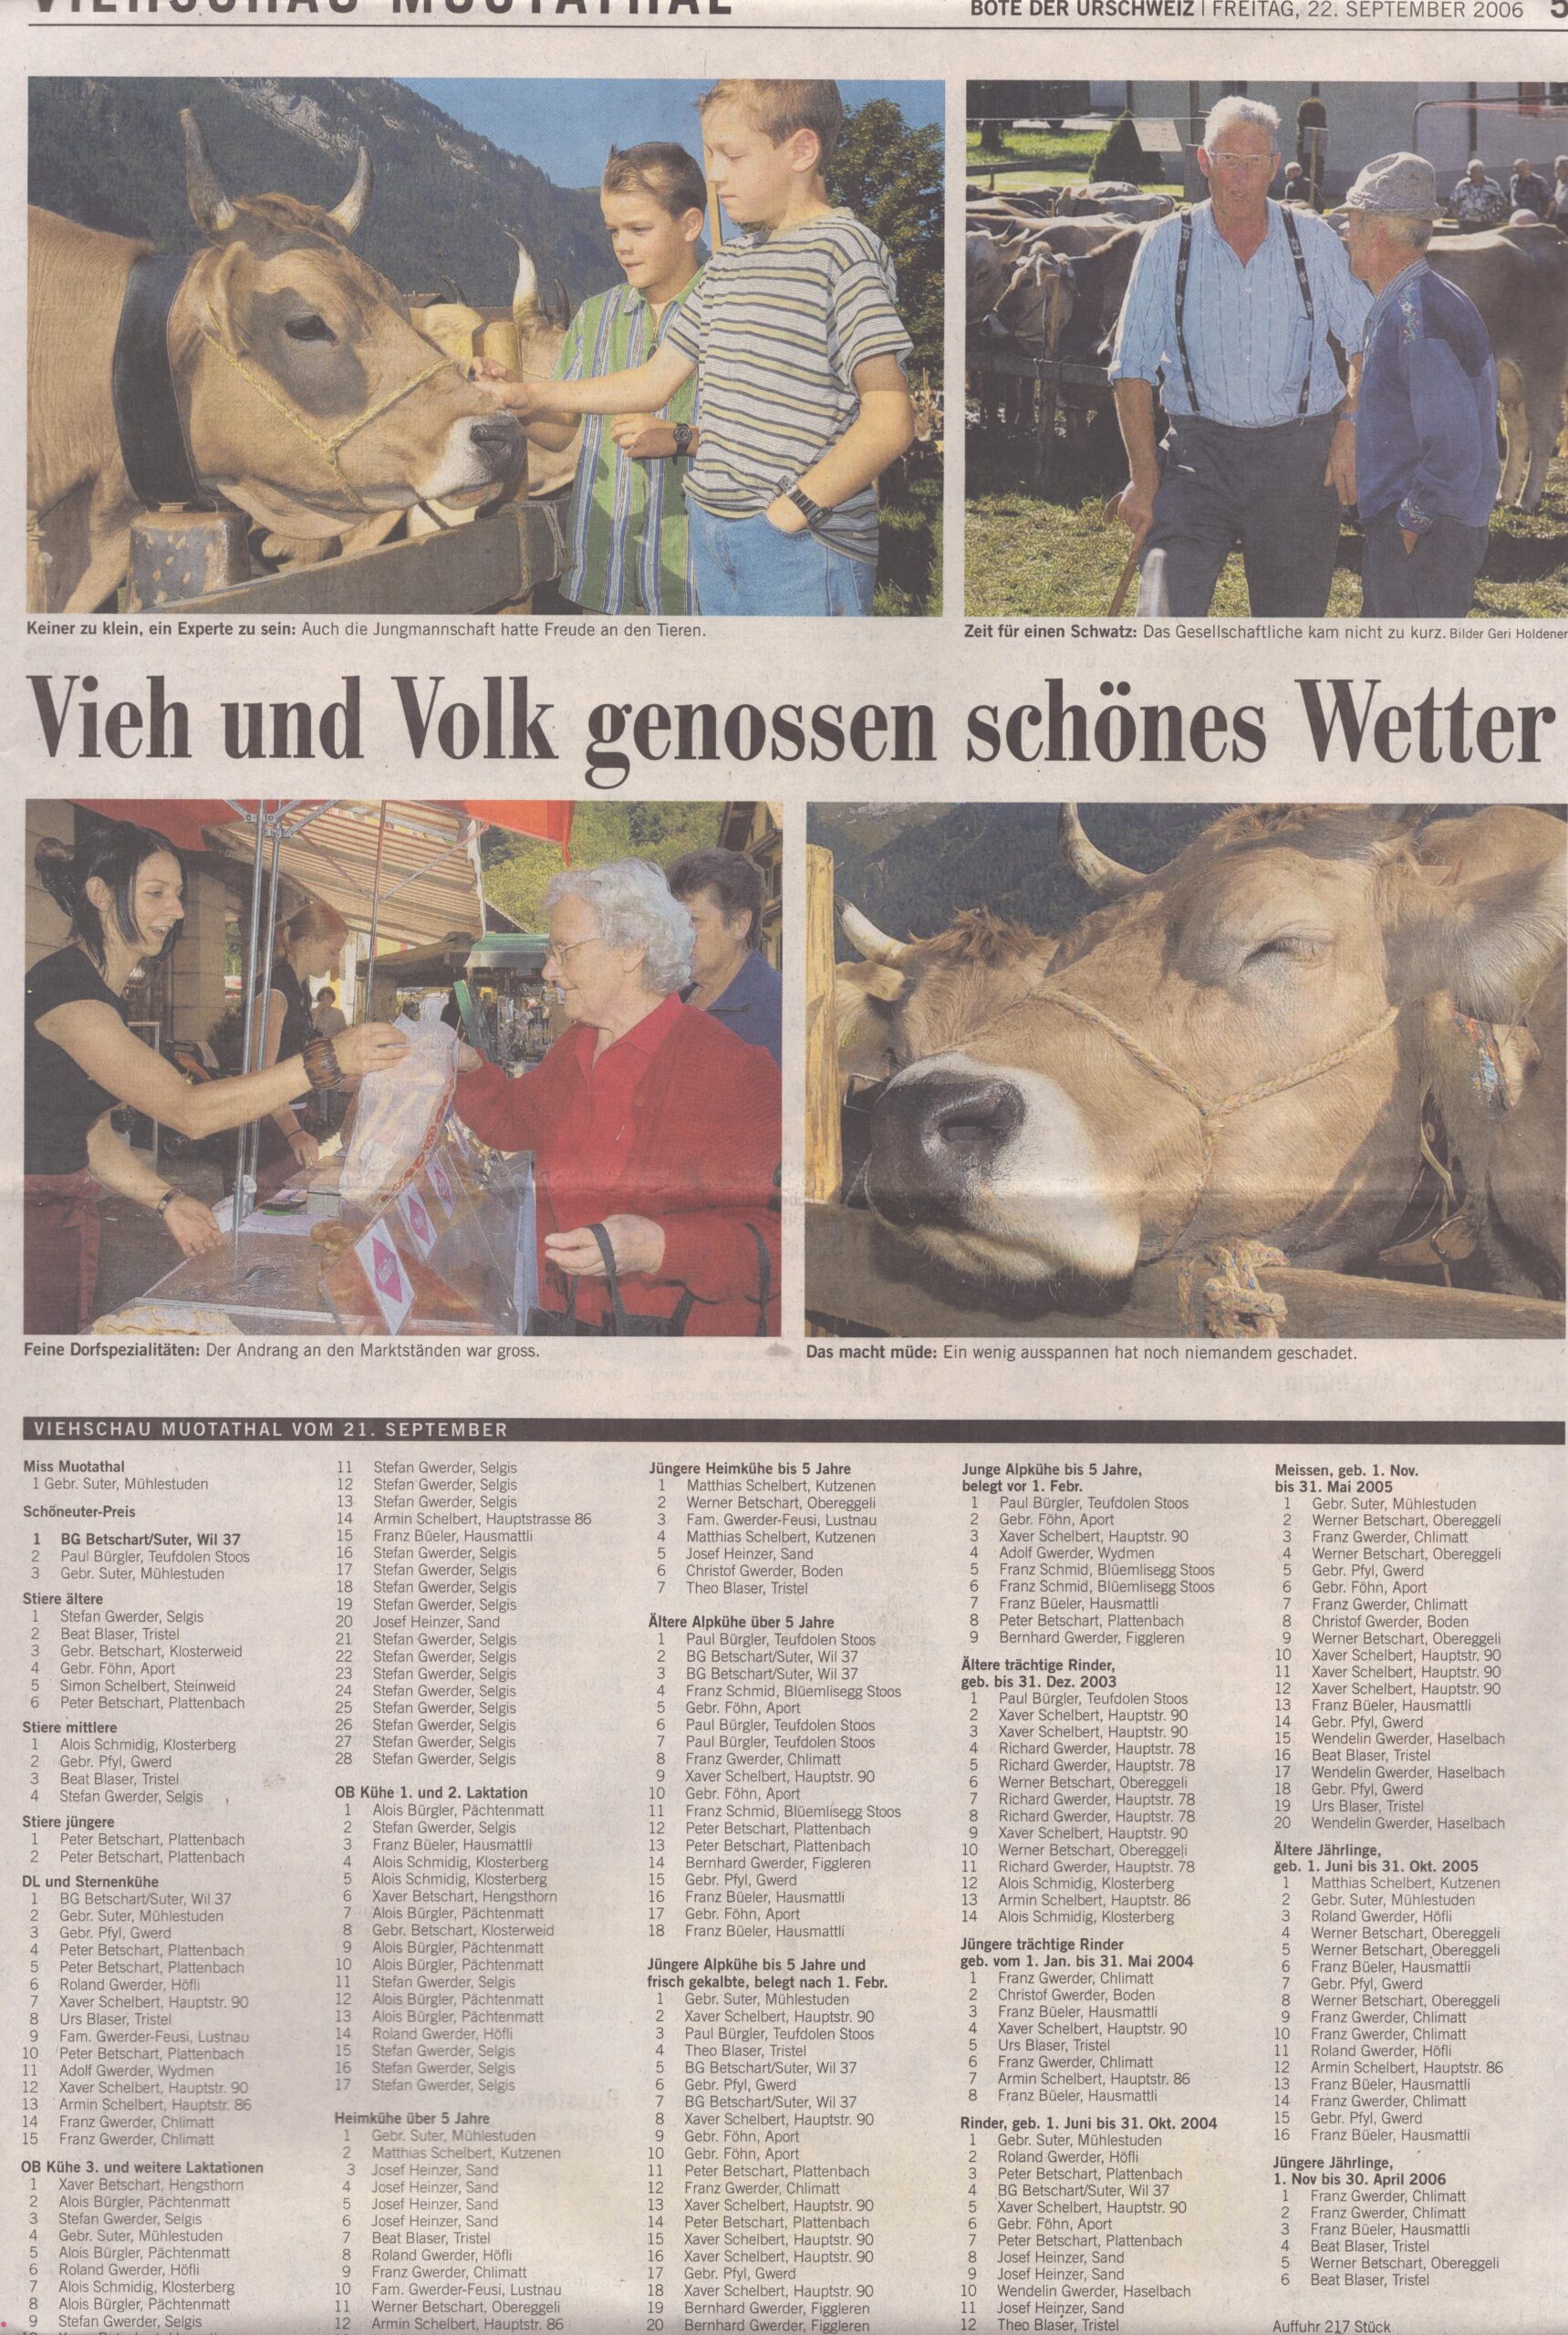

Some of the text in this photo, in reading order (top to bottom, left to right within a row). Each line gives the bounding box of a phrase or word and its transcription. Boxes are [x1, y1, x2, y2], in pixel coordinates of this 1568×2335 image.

[971, 0, 1523, 19] BOTE DER URSCHWEIZ FREITAG, 22. SEPTEMBER 2006
[27, 621, 705, 638] Keiner zu klein, ein Experte zu sein: Auch die Jungmannschaft hatte Freude an den Tieren.
[964, 624, 1445, 638] Zeit für einen Schwatz: Das Gesellschaftliche kam nicht zu kurz.
[1450, 628, 1568, 638] Bilder Geri Holdener
[26, 675, 1556, 790] Vieh und Volk genossen schönes Wetter
[25, 1343, 539, 1360] Feine Dorfspezialitäten: Der Andrang an den Marktständen war gross.
[807, 1344, 1356, 1362] Das macht müde: Ein wenig ausspannen hat noch niemandem geschadet.
[35, 1422, 506, 1437] VIEHSCHAU MUOTATHAL VOM 21. SEPTEMBER
[24, 1460, 124, 1472] Miss Muotathal
[649, 1462, 851, 1477] Jüngere Heimkühe bis 5 Jahre
[1275, 1464, 1418, 1479] Meissen, geb. 1. Nov.
[34, 1478, 208, 1491] 1 Gebr. Suter, Mühlestuden
[1275, 1480, 1393, 1493] bis 31. Mai 2005
[24, 1504, 135, 1518] Schöneuter-Preis
[337, 1512, 591, 1527] 14 Armin Schelbert, Hauptstrasse 86
[34, 1533, 241, 1547] 1 BG Betschart/Suter, Wil 37
[657, 1564, 843, 1578] 6 Christof Gwerder, Boden
[23, 1593, 103, 1604] Stiere ältere
[649, 1613, 834, 1631] Ältere Alpkühe über 5 Jahre
[961, 1655, 1115, 1674] Ältere trächtige Rinder,
[961, 1676, 1116, 1690] geb. bis 31. Dez. 2003
[335, 1786, 527, 1799] OB Kühe 1. und 2. Laktation
[23, 1875, 159, 1887] DL und Sternenkühe
[335, 2112, 490, 2124] Heimkühe über 5 Jahre
[21, 2161, 263, 2173] OB Kühe 3. und weitere Laktationen
[1273, 2156, 1393, 2171] Jüngere Jährlinge,
[1274, 2173, 1446, 2188] 1. Nov bis 30. April 2006
[961, 2284, 1190, 2299] 10 Wendelin Gwerder, Haselbach
[1272, 2320, 1391, 2333] Auffuhr 217 Stück
